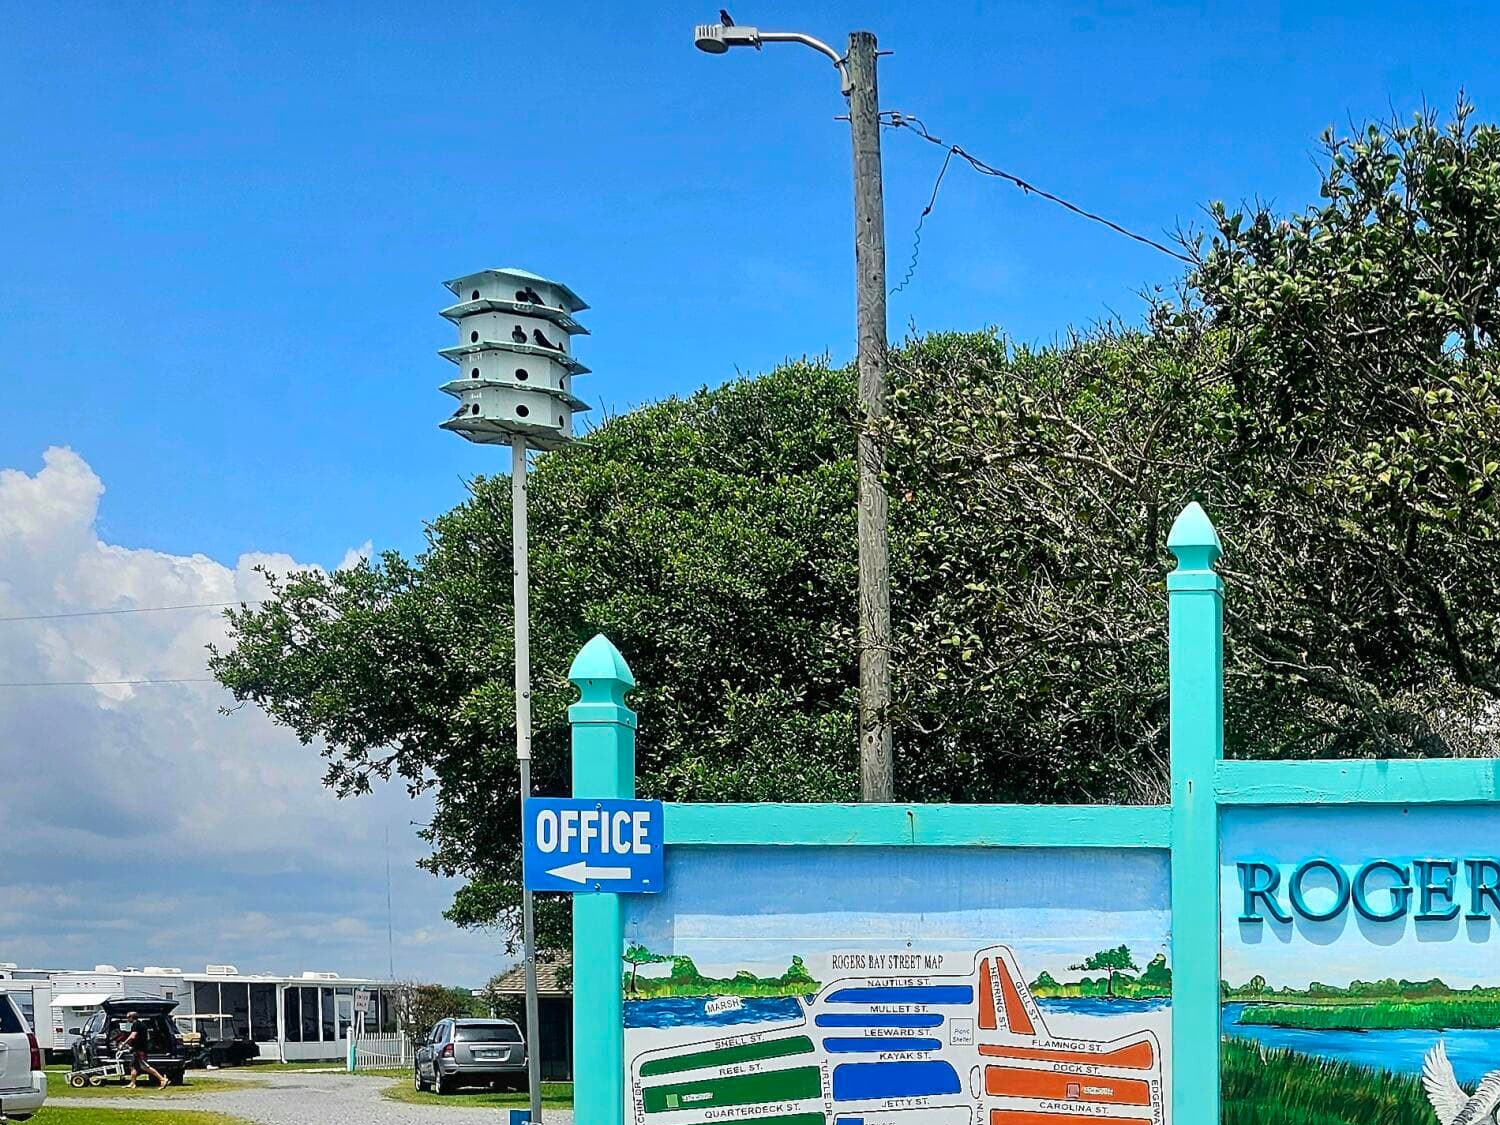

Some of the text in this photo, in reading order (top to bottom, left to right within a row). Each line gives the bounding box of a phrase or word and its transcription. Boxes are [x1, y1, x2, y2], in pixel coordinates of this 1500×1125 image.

[536, 809, 651, 854] OFFICE
[832, 955, 944, 969] ROGERS BAY STREET MAP
[867, 979, 914, 987] NAUTILIS
[990, 967, 1005, 1014] HERRING
[707, 998, 739, 1013] MARSH
[870, 1005, 928, 1013] MULLET ST.
[1015, 981, 1040, 1024] GULL ST.
[864, 1029, 932, 1037] LEEWARD ST.
[714, 1034, 766, 1049] SHELL ST.
[1031, 1039, 1103, 1052] FLAMINGO ST.
[879, 1052, 932, 1060] KAYAK ST.
[719, 1063, 763, 1076] REEL ST.
[1053, 1063, 1101, 1075] DOCK ST.
[820, 1058, 832, 1099] TURTLE
[881, 1098, 930, 1108] JETTY ST.
[1039, 1101, 1110, 1115] CAROLINA ST.
[704, 1103, 801, 1118] QUARTERDECK ST.
